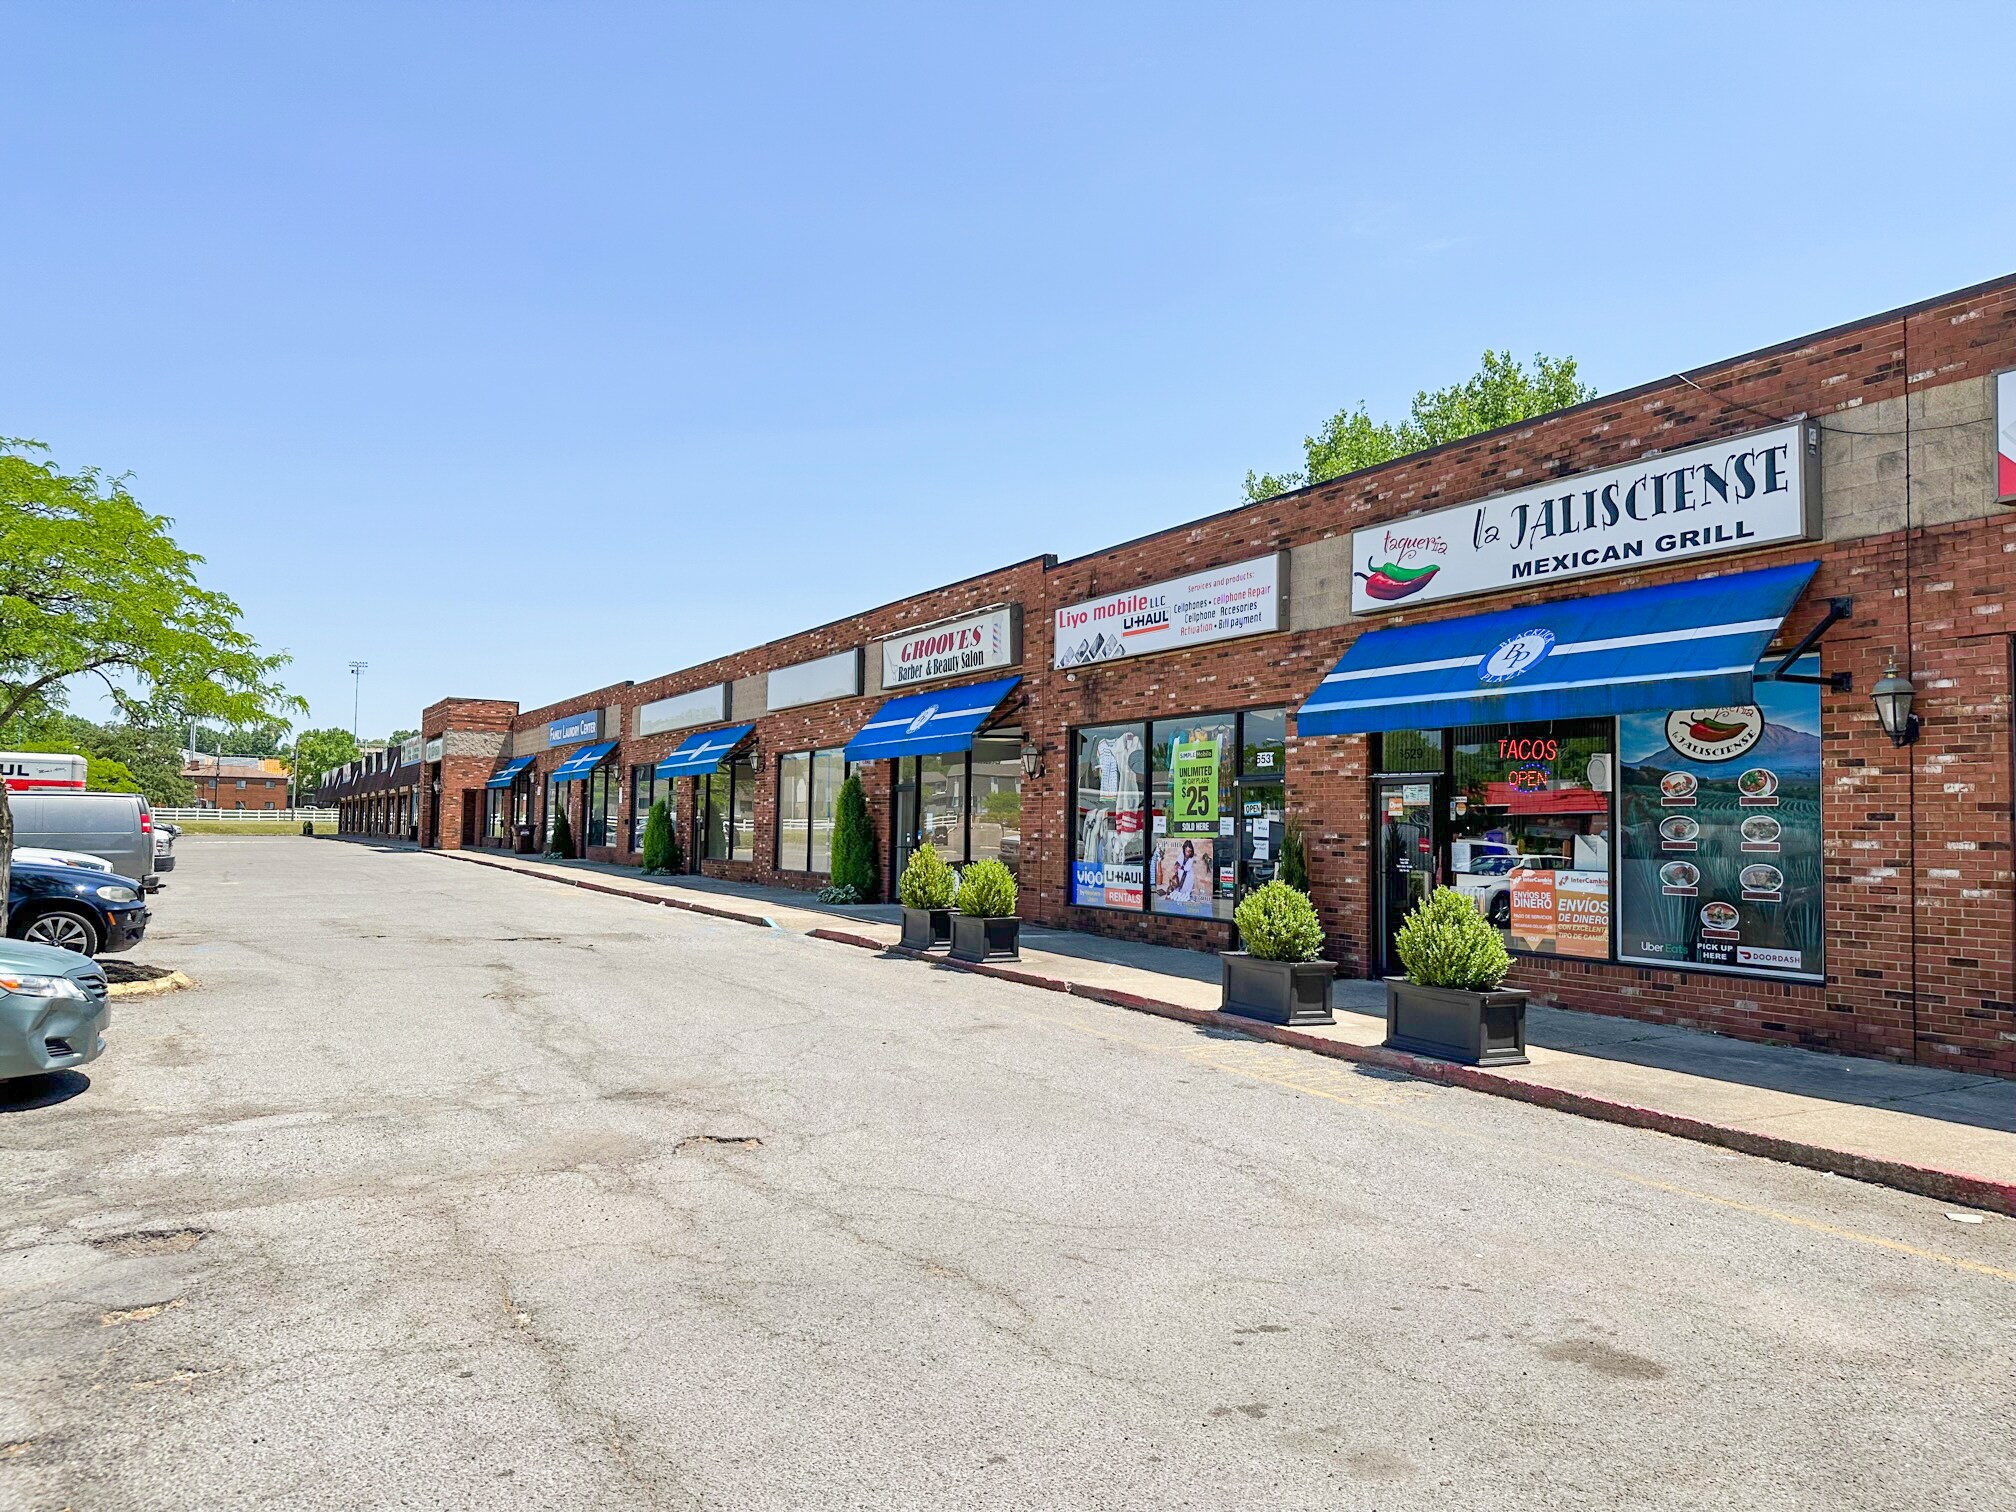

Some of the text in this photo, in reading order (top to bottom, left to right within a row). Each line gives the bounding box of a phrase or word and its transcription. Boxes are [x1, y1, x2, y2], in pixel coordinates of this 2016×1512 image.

[1510, 443, 1788, 550] JALISCIENSE
[1512, 521, 1754, 579] MEXICAN GRILL
[1213, 578, 1225, 587] and
[1174, 584, 1271, 614] Cellphones cellphone Repair
[1059, 595, 1166, 629] Liyo mobile LLC
[1123, 610, 1169, 630] U-HAUL
[1184, 601, 1258, 624] Cellphone Accesories
[1180, 621, 1213, 636] Activation
[1230, 612, 1262, 629] payment
[901, 625, 984, 662] GROOVES
[898, 650, 984, 681] Barber & Beauty Salon
[1480, 668, 1526, 683] PLAZA
[1498, 739, 1557, 761] TACOS
[1677, 729, 1756, 757] JALISCIENSE
[1180, 765, 1212, 778] UNLIMITED
[1508, 770, 1548, 787] OPEN
[1245, 804, 1261, 814] OPEN
[1182, 822, 1210, 832] SOLD HERE
[1077, 866, 1104, 889] vigo
[1109, 892, 1141, 904] RENTALS
[1513, 898, 1552, 909] DINERO
[1541, 892, 1551, 900] DE
[1558, 896, 1609, 914] ENVÍOS
[1559, 913, 1608, 925] DE DINERO
[1641, 941, 1689, 954] Uber Eats
[1697, 942, 1733, 952] PICK UP
[1702, 952, 1727, 961] HERE
[1753, 952, 1801, 964] DOORDASH
